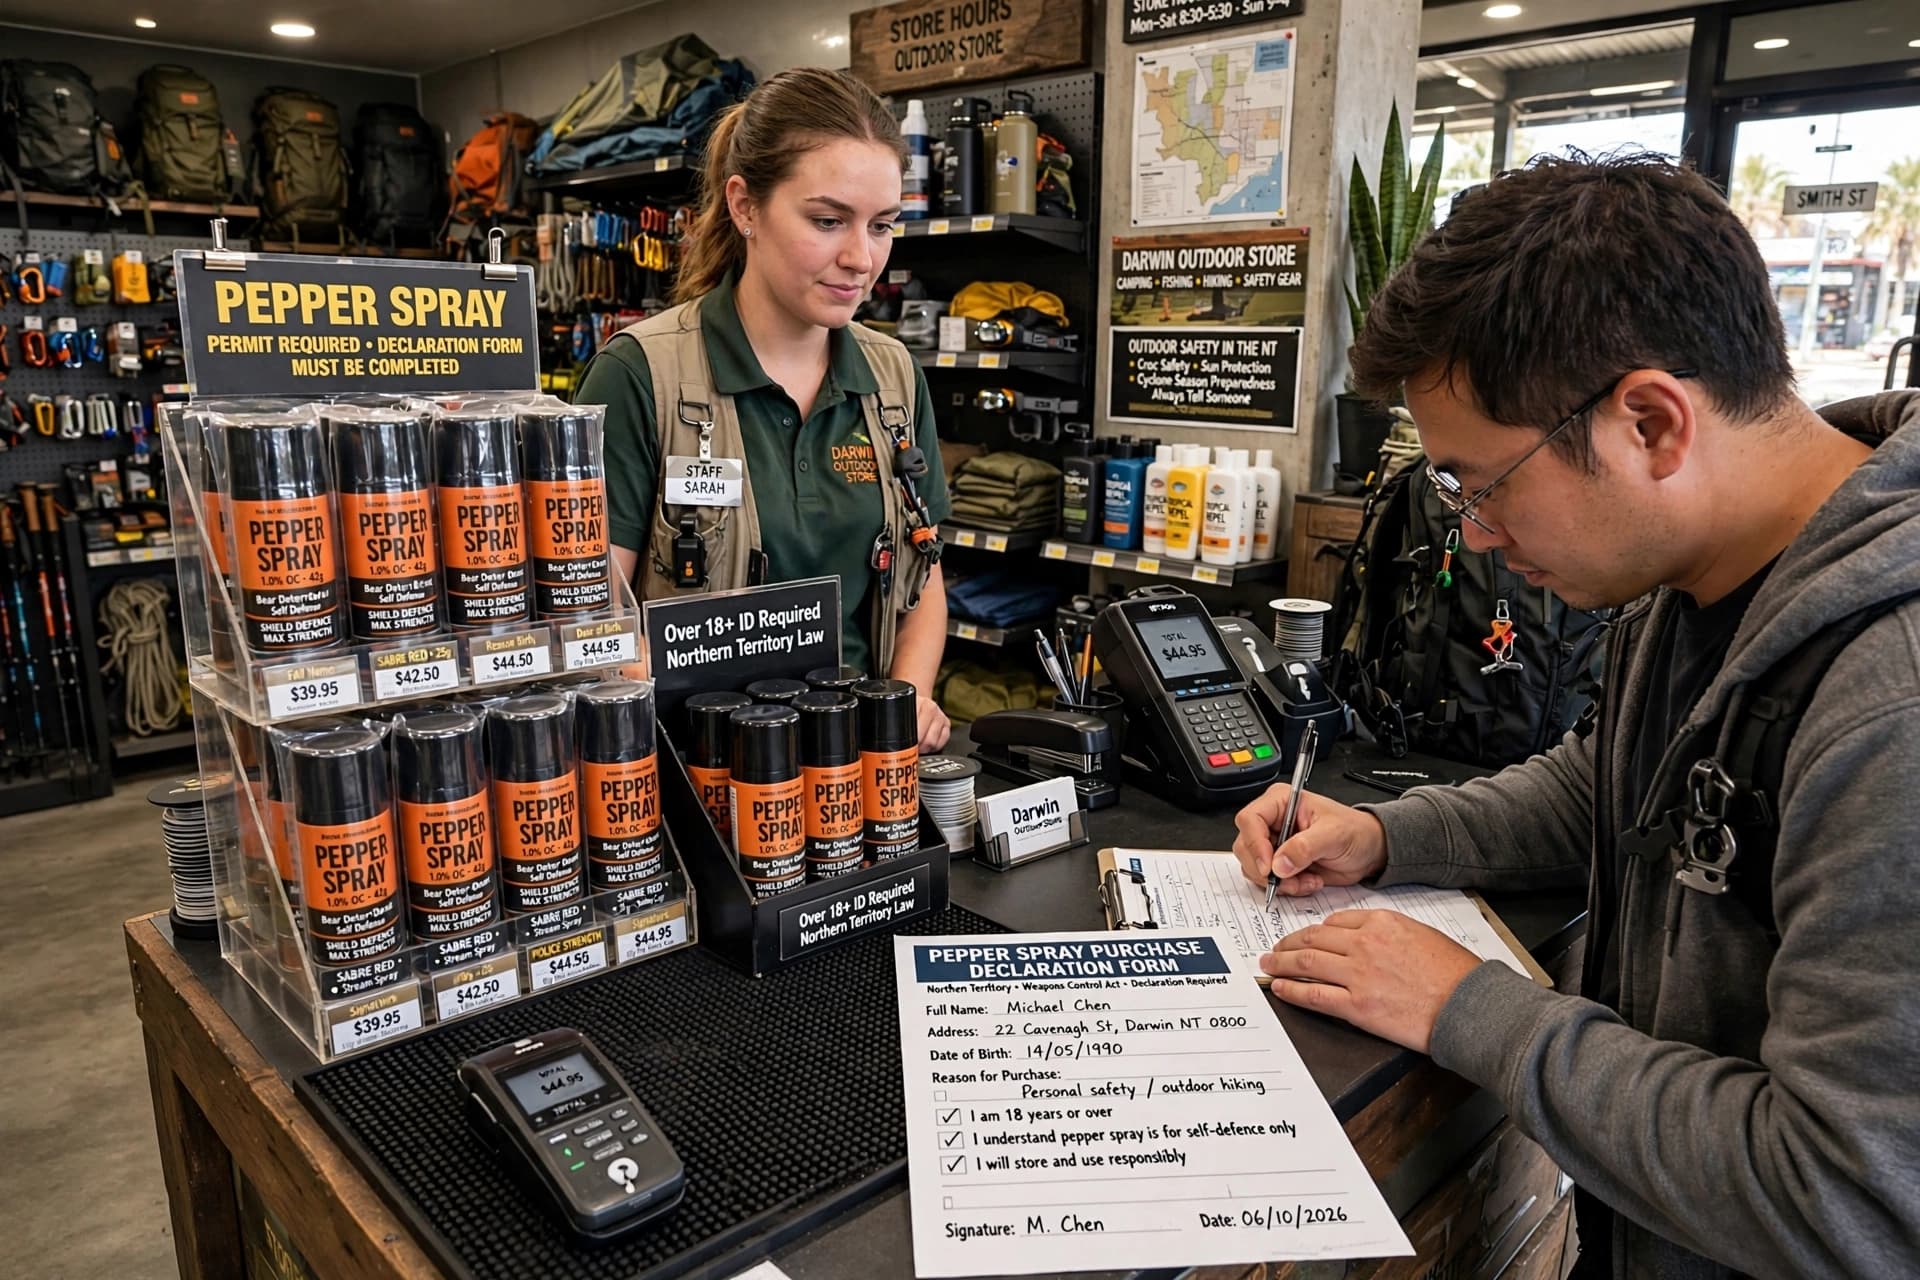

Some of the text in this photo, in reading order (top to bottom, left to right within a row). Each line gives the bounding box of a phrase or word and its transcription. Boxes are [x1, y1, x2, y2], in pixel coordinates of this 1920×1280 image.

[1241, 0, 1264, 15] Sun
[890, 0, 1012, 43] STORE HOURS
[895, 29, 1005, 72] OUTDOOR STORE
[1797, 188, 1868, 208] SMITH ST
[1122, 244, 1297, 271] DARWIN OUTDOOR STORE
[1116, 272, 1302, 290] CAMPING FISHING HIKING SAFETY GEAR
[214, 279, 508, 328] PEPPER SPRAY
[207, 334, 523, 354] PERMIT REQUIRED DECLARATION FORM
[1128, 338, 1278, 357] OUTDOOR SAFETY IN THE NT
[291, 358, 460, 376] MUST BE COMPLETED
[1136, 358, 1271, 375] Croc Safety Sun Protection
[1136, 373, 1276, 392] Cyclone Season Preparedness
[1152, 388, 1251, 405] Always Tell Someone
[685, 464, 723, 479] STAFF
[684, 480, 726, 495] SARAH
[359, 508, 428, 536] PEPPER
[457, 502, 521, 528] PEPPER
[249, 515, 325, 545] PEPPER
[464, 526, 519, 553] SPRAY
[257, 543, 322, 572] SPRAY
[366, 534, 425, 562] SPRAY
[664, 600, 821, 644] Over 18+ ID Required
[376, 650, 428, 667] SABRE RED
[582, 638, 620, 657] $44.95
[666, 628, 825, 669] Northern Territory Law
[1161, 643, 1207, 662] $44.95
[492, 652, 533, 671] $44.50
[395, 666, 440, 686] $42.50
[290, 680, 339, 702] $39.95
[600, 771, 657, 801] PEPPER
[513, 790, 575, 822] PEPPER
[606, 794, 656, 824] SPRAY
[1011, 797, 1060, 825] Darwin
[418, 811, 486, 845] PEPPER
[519, 814, 573, 845] SPRAY
[314, 833, 389, 869] PEPPER
[426, 836, 485, 869] SPRAY
[322, 859, 386, 895] SPRAY
[799, 877, 915, 929] Over 18+ ID Required
[800, 898, 915, 947] Northern Territory Law
[439, 930, 493, 955] SABRE RED
[562, 931, 602, 951] STRENGTH
[634, 925, 672, 947] $44.95
[928, 941, 1206, 963] PEPPER SPRAY PURCHASE
[336, 960, 395, 983] SABRE RED
[969, 958, 1180, 979] DECLARATION FORM
[456, 979, 500, 1004] $42.50
[1022, 982, 1065, 992] Weapons
[1067, 980, 1102, 990] Control
[1105, 979, 1121, 989] Act
[1131, 977, 1185, 988] Declaration
[1186, 975, 1228, 988] Required
[926, 998, 1111, 1016] Full Name: Michael Chen
[353, 1009, 401, 1036] $39.95
[927, 1016, 1247, 1039] Address: 22 Cavenagh St, Darwin NT 0800
[930, 1041, 1123, 1061] Date of Birth: 14/05/1990
[932, 1068, 1062, 1083] Reason for Purchase:
[1022, 1076, 1266, 1100] Personal safety outdoor hiking
[970, 1107, 1113, 1124] I am 18 years or over
[973, 1119, 1297, 1147] I understand pepper spray is for self-defence only
[976, 1157, 982, 1171] I
[986, 1156, 1010, 1170] will
[1015, 1156, 1049, 1170] store
[1053, 1152, 1077, 1168] and
[1081, 1155, 1105, 1167] use
[945, 1213, 1105, 1241] Signature: M. Chen
[1199, 1204, 1348, 1231] Date: 06/10/2026
